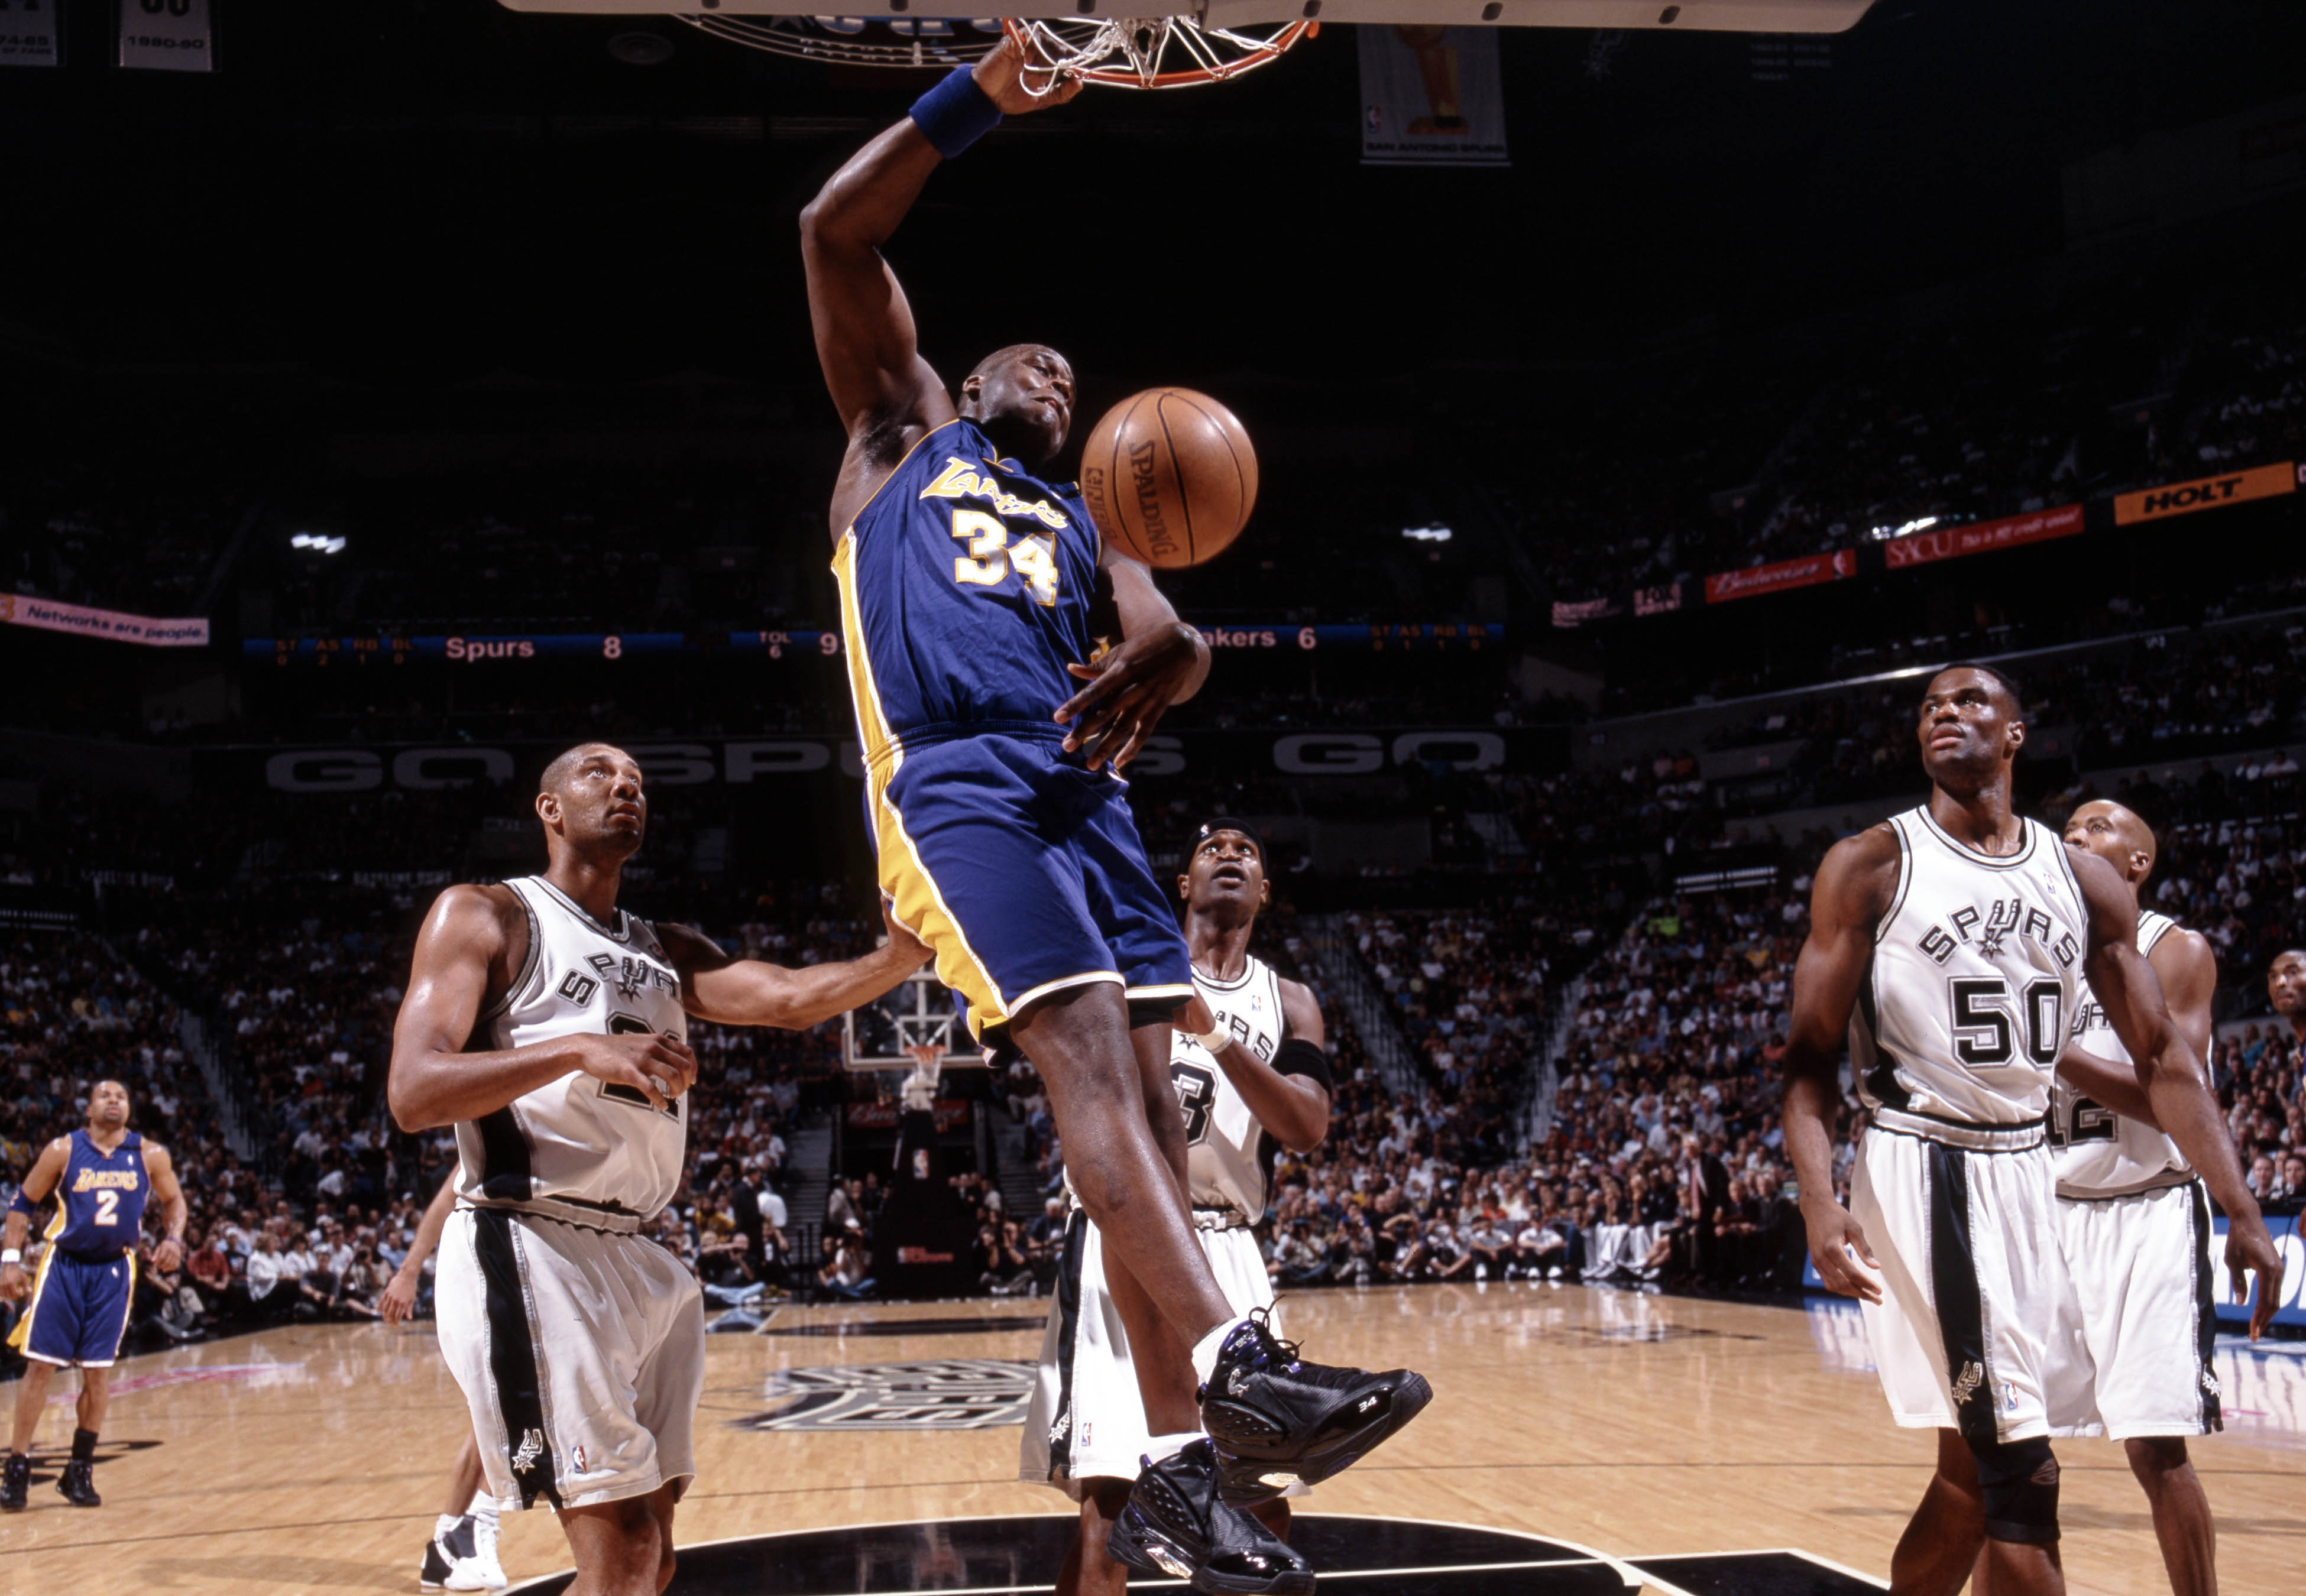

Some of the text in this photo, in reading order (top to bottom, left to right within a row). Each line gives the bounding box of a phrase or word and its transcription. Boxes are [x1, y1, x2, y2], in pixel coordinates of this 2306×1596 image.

[1128, 440, 1178, 557] SPALDING
[2144, 476, 2243, 514] HOLT
[952, 510, 1058, 606] 34
[27, 605, 110, 631] Networks
[115, 621, 141, 635] are
[445, 638, 535, 663] Spurs
[603, 636, 622, 660] 8
[1203, 628, 1277, 648] akers
[1297, 627, 1318, 650] 6
[1916, 898, 2080, 970] SPURS
[556, 951, 679, 1009] SPUR
[1947, 975, 2064, 1068] 50
[72, 1168, 138, 1192] LAKERS
[95, 1189, 119, 1226] 2
[1359, 1396, 1377, 1413] 34
